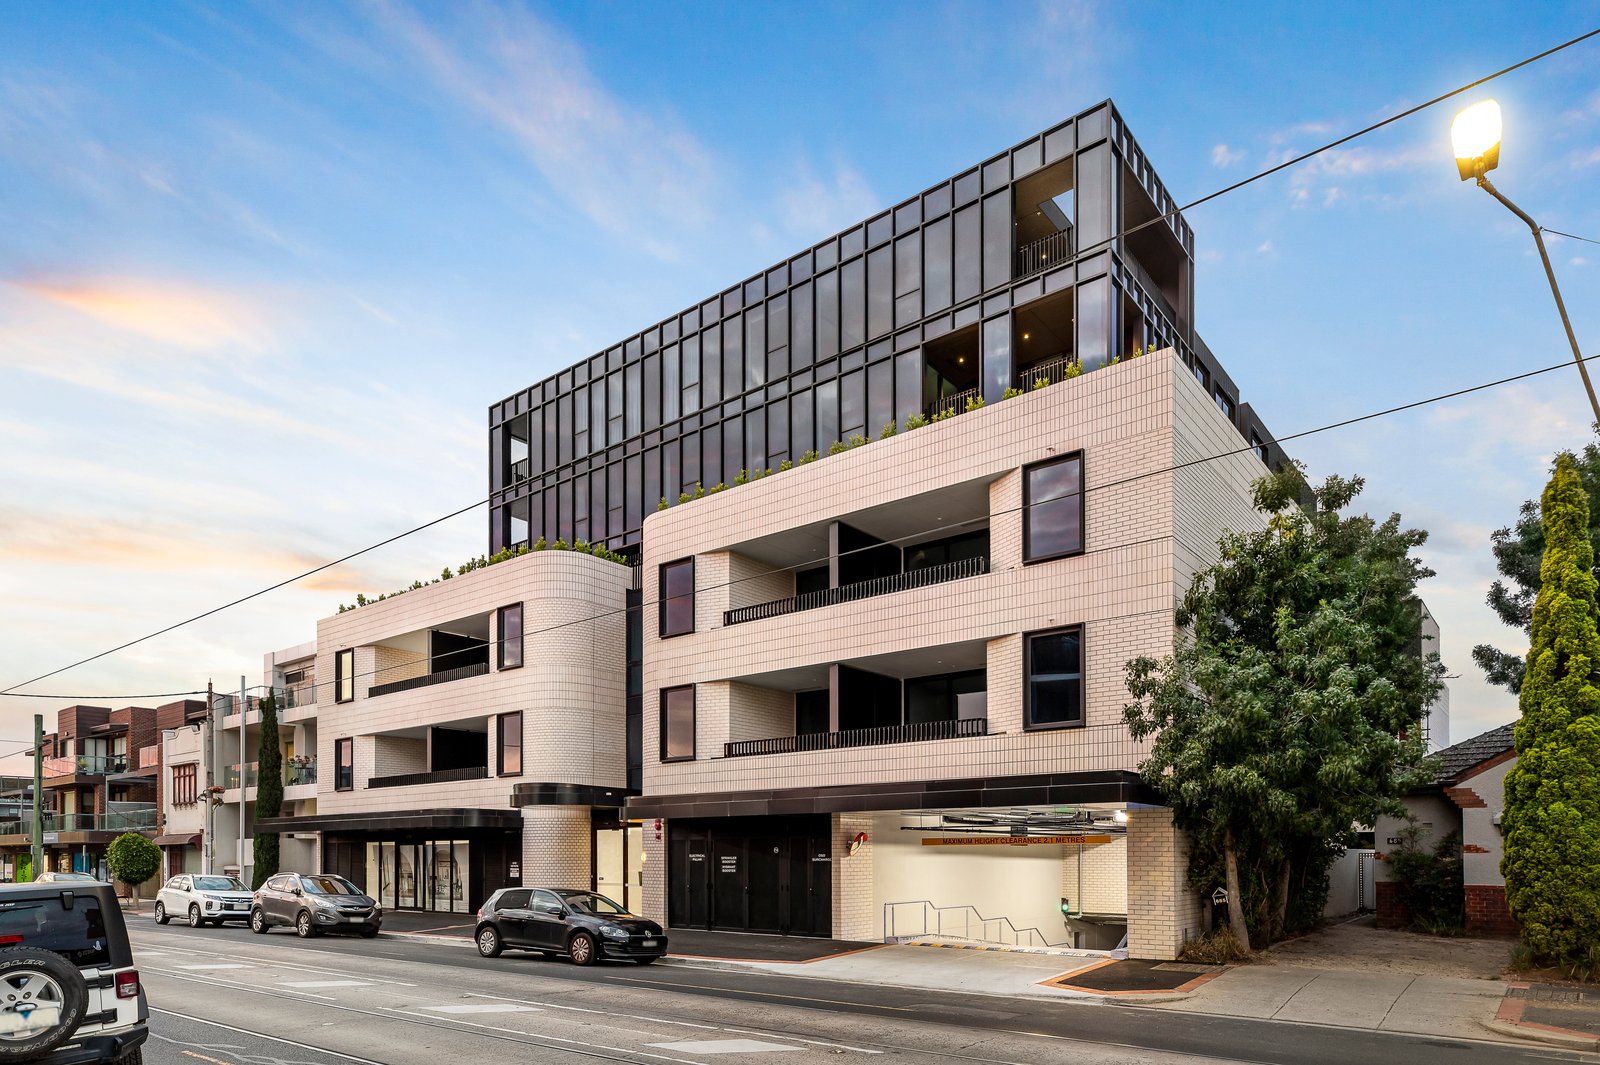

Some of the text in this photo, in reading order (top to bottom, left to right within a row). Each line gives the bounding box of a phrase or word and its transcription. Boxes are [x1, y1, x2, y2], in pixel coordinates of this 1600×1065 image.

[943, 836, 1086, 845] MAXIMUM HEIGHT CLEARANCE 2.1 METRES
